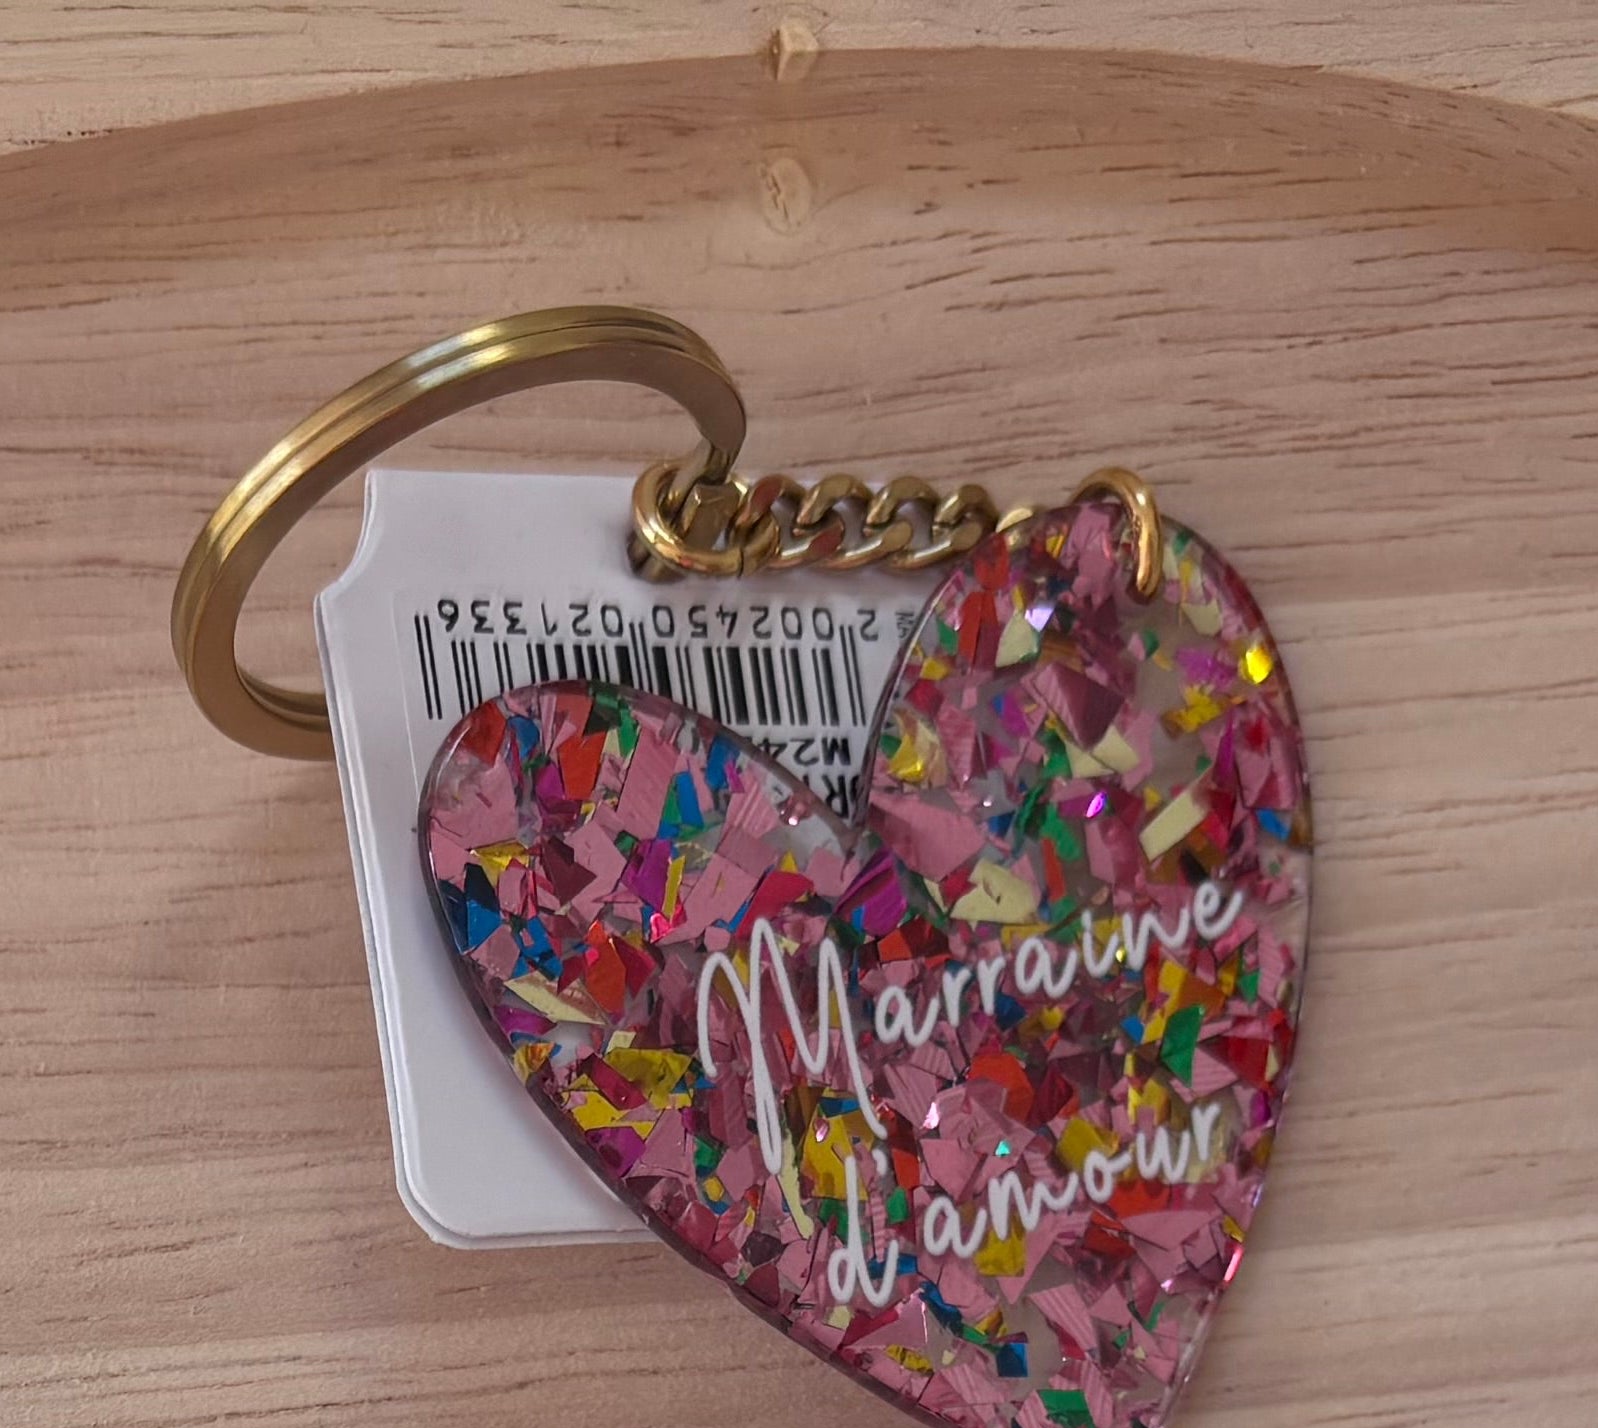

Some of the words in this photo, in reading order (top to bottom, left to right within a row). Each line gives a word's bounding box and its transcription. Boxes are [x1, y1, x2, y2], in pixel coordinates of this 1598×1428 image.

[436, 599, 624, 639] 021336
[651, 603, 835, 641] 002450
[857, 609, 879, 641] 2
[698, 876, 1250, 1177] Marraine
[825, 1093, 1223, 1306] d'amour
